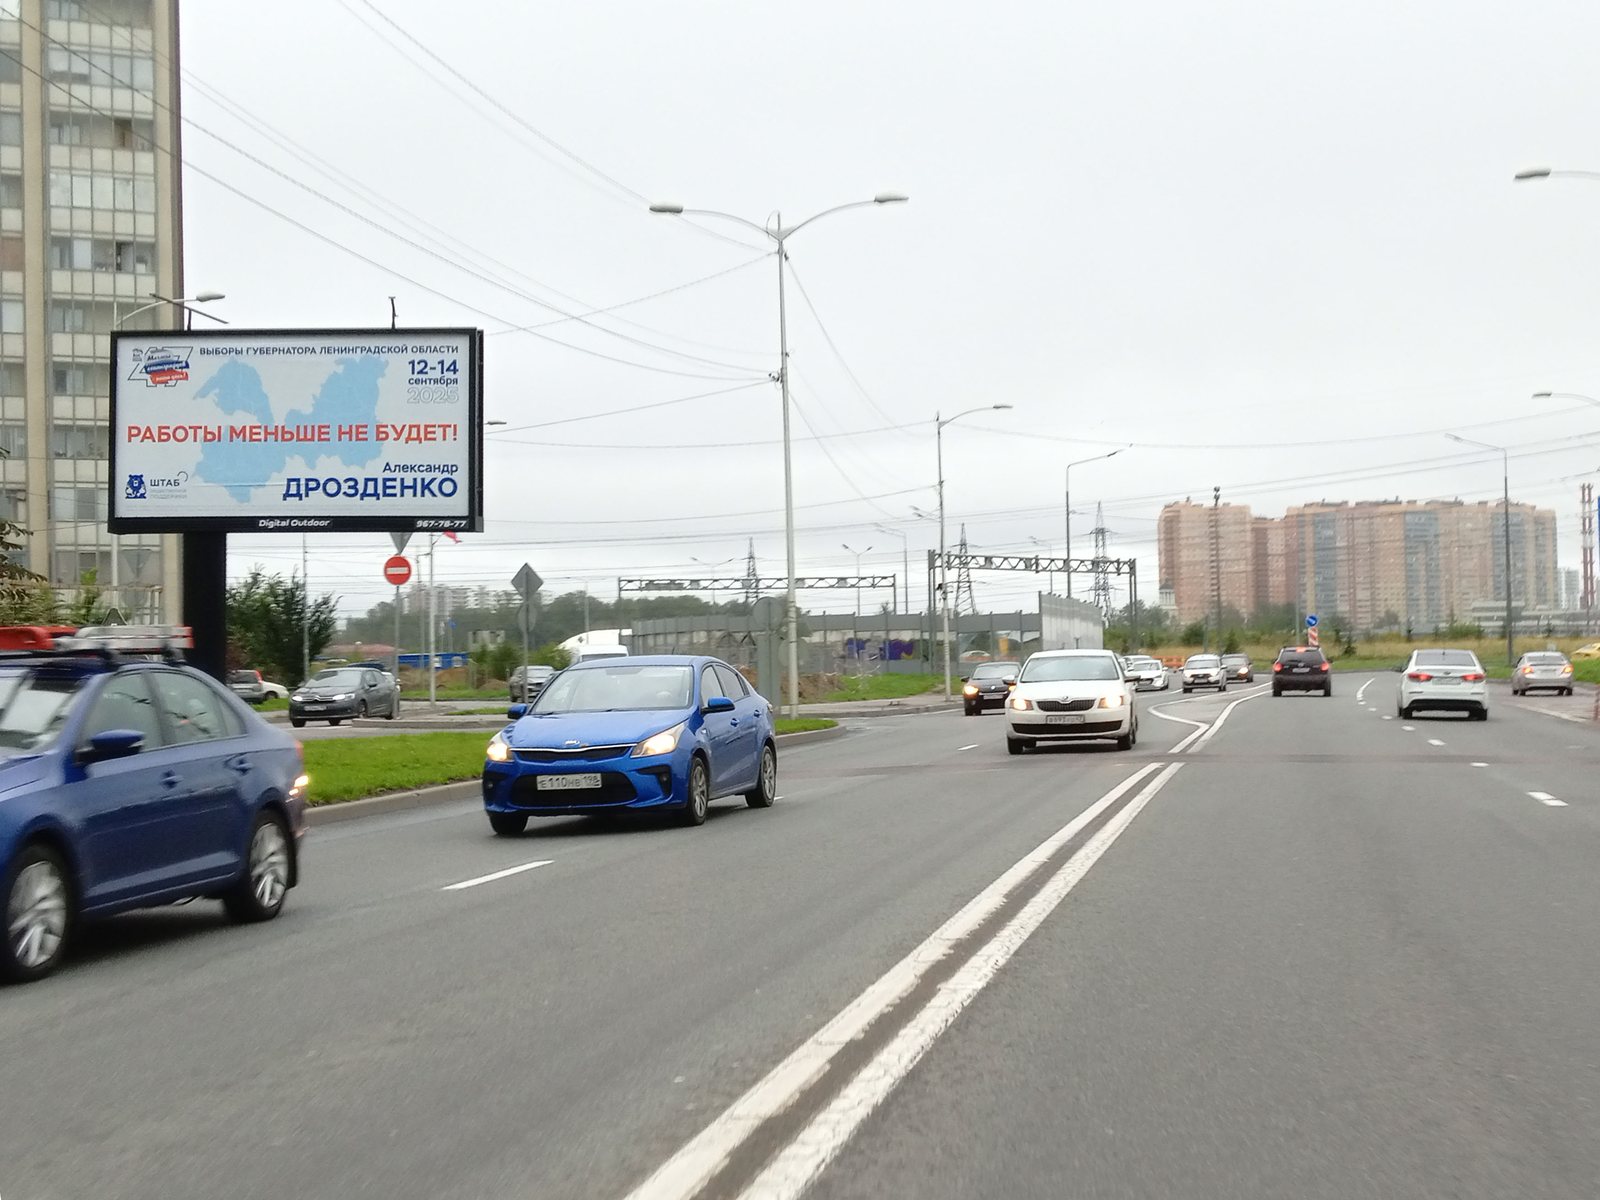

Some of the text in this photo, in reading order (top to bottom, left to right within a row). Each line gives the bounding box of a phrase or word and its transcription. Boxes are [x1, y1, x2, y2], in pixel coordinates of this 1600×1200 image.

[199, 344, 459, 356] ВЫБОРЫ ГУБЕРНАТОРА ЛЕНИНГРАДСКОЙ ОБЛАСТИ
[408, 359, 459, 375] 12-14
[408, 376, 459, 387] сентября
[407, 387, 460, 404] 2025
[127, 423, 458, 444] РАБОТЫ МЕНЬШЕ НЕ БУДЕТ!
[382, 461, 459, 476] Александр
[150, 479, 180, 487] ШТАБ
[282, 477, 458, 501] ДРОЗДЕНКО
[258, 519, 331, 529] Digital Outdoor
[415, 519, 467, 528] 967-78-77
